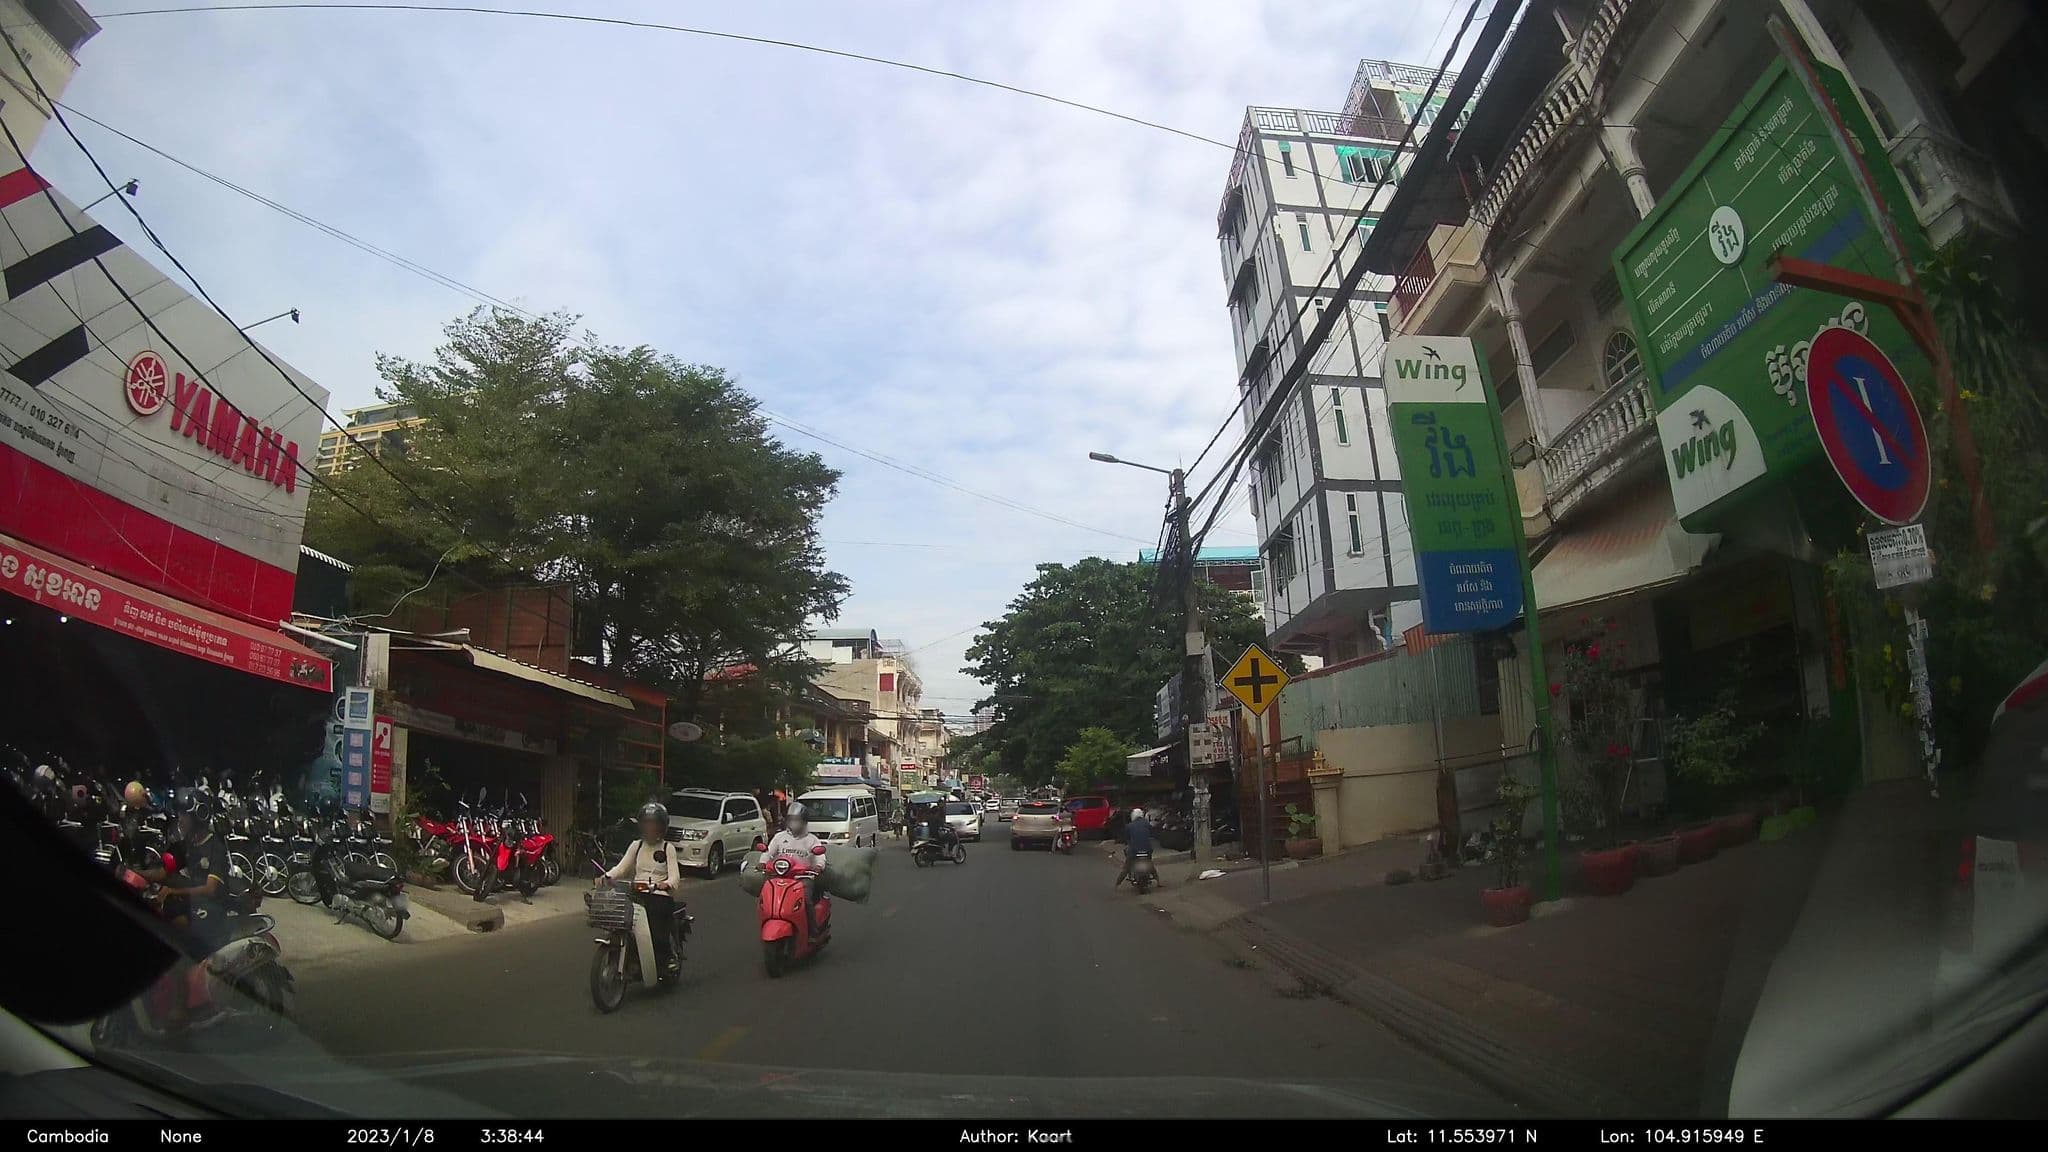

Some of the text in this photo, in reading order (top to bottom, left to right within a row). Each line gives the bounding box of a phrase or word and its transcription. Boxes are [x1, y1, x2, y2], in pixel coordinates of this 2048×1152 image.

[1711, 221, 1740, 258] វីង
[1395, 359, 1467, 392] Wing
[30, 405, 46, 422] 010
[47, 414, 64, 430] 327
[170, 372, 299, 494] YAMAHA
[1671, 419, 1737, 479] Wing
